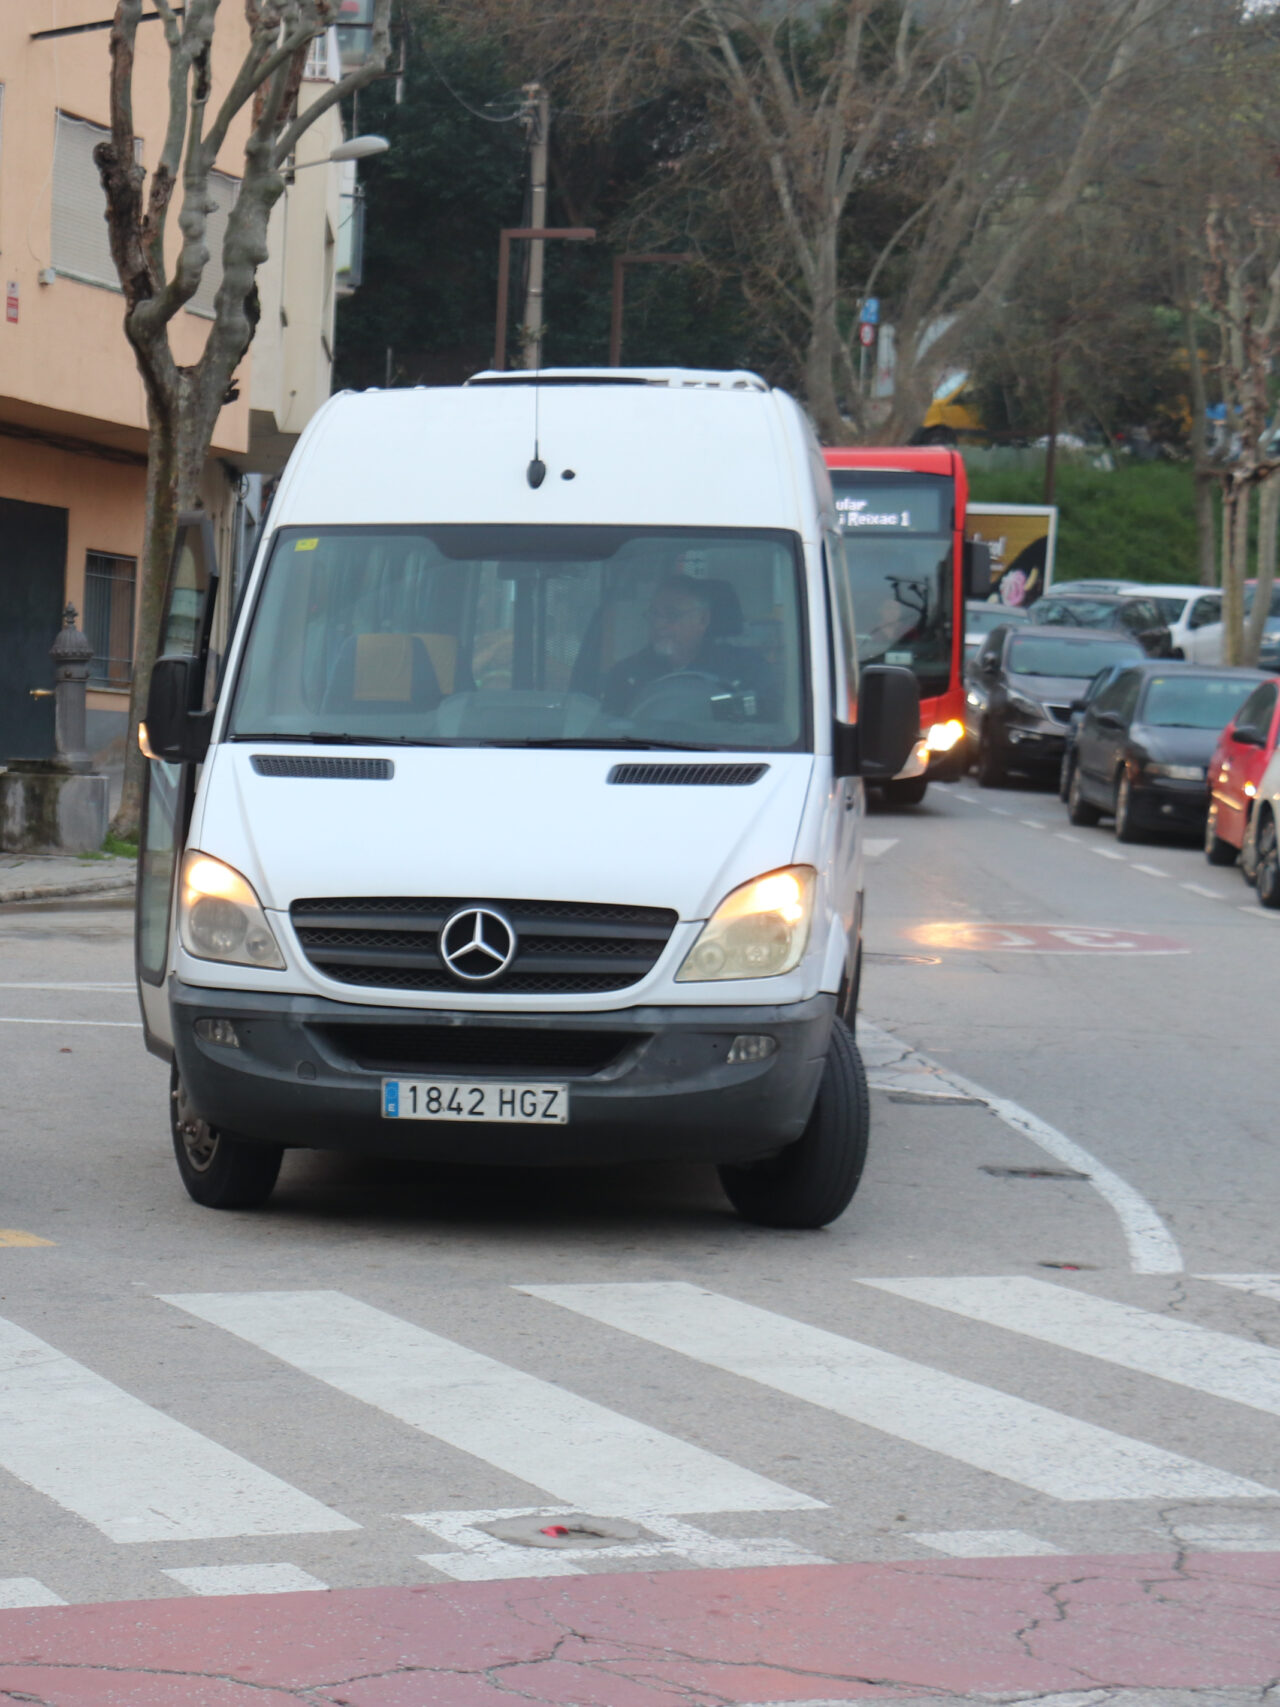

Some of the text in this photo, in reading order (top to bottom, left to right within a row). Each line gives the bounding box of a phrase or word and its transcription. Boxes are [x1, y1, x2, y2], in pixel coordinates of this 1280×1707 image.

[835, 497, 867, 511] ular
[847, 511, 898, 527] Reixac
[901, 510, 910, 527] 1
[388, 1103, 395, 1112] E
[409, 1085, 558, 1119] 1842 HGZ
